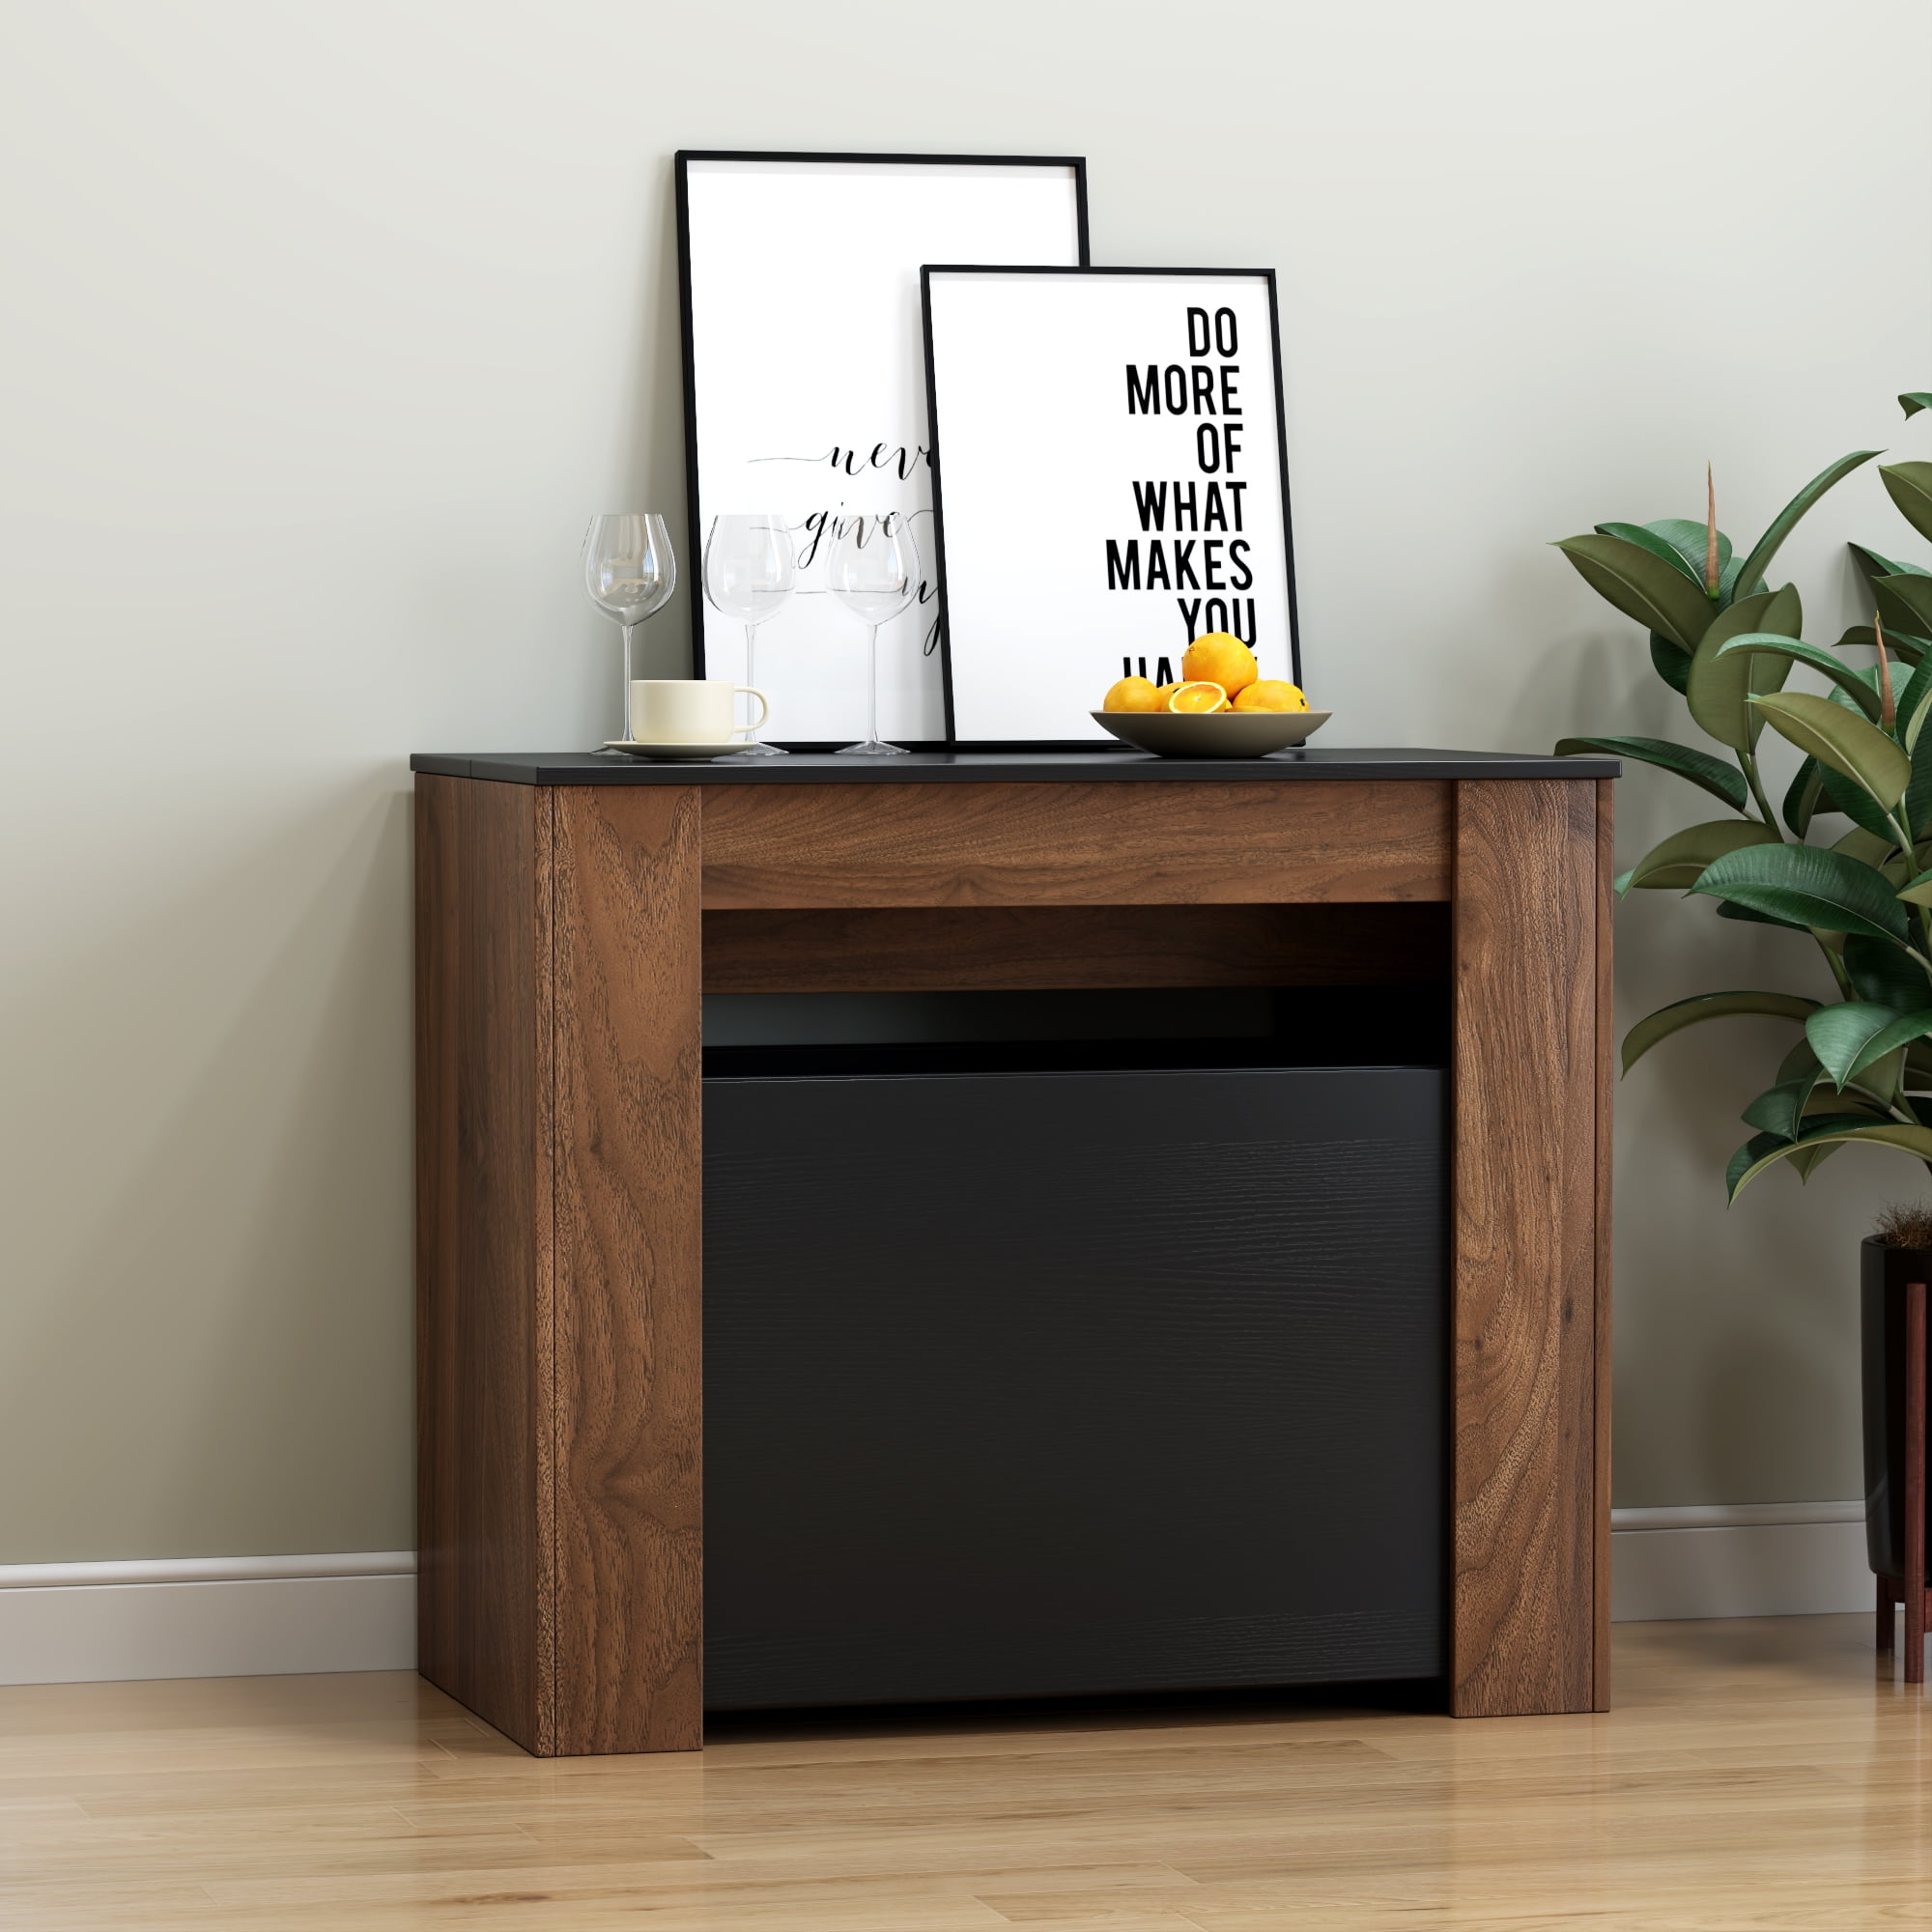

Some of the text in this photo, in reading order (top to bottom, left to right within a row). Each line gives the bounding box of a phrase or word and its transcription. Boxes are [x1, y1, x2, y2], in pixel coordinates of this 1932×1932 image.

[1187, 307, 1237, 357] DO
[1126, 364, 1242, 415] MORE
[819, 442, 932, 481] nev
[1197, 423, 1243, 473] OF
[1132, 481, 1247, 531] WHAT
[796, 500, 905, 570] give
[1106, 539, 1253, 591] MAKES
[1177, 597, 1257, 649] YOU
